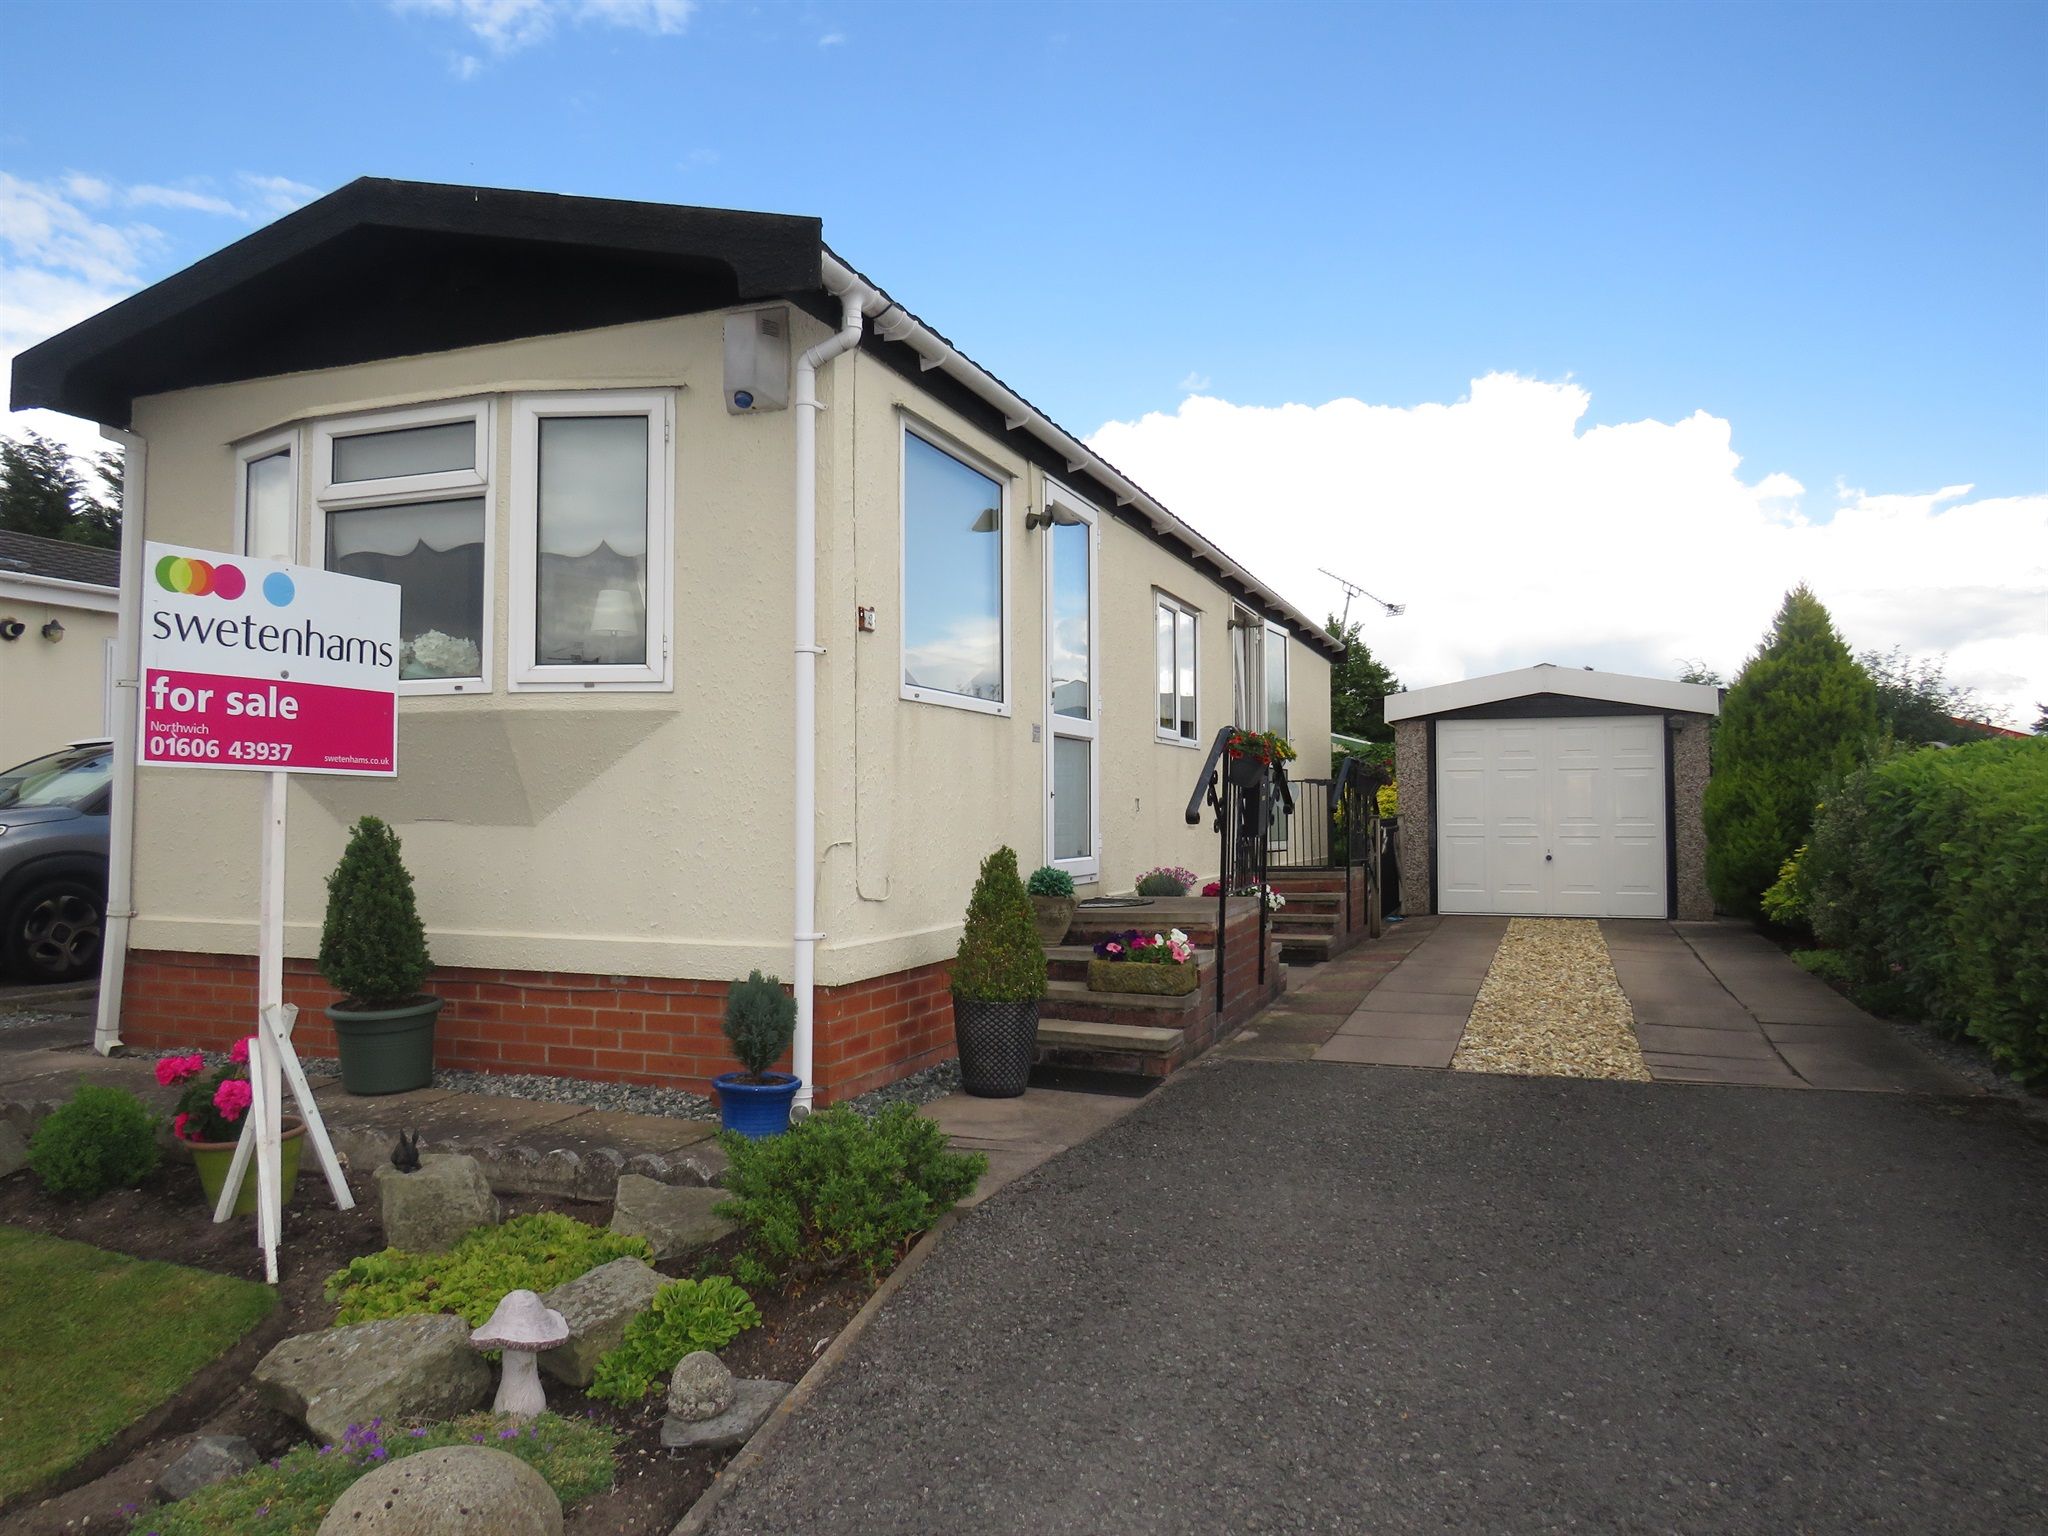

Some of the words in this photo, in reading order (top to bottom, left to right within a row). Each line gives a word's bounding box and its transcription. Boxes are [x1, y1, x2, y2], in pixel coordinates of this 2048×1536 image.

[152, 611, 393, 668] swetenhams
[151, 676, 214, 713] for
[226, 685, 299, 720] sale
[150, 720, 209, 734] Northwich
[150, 736, 220, 758] 01606
[228, 741, 293, 761] 43937
[324, 755, 390, 765] swetenhams.co.uk
